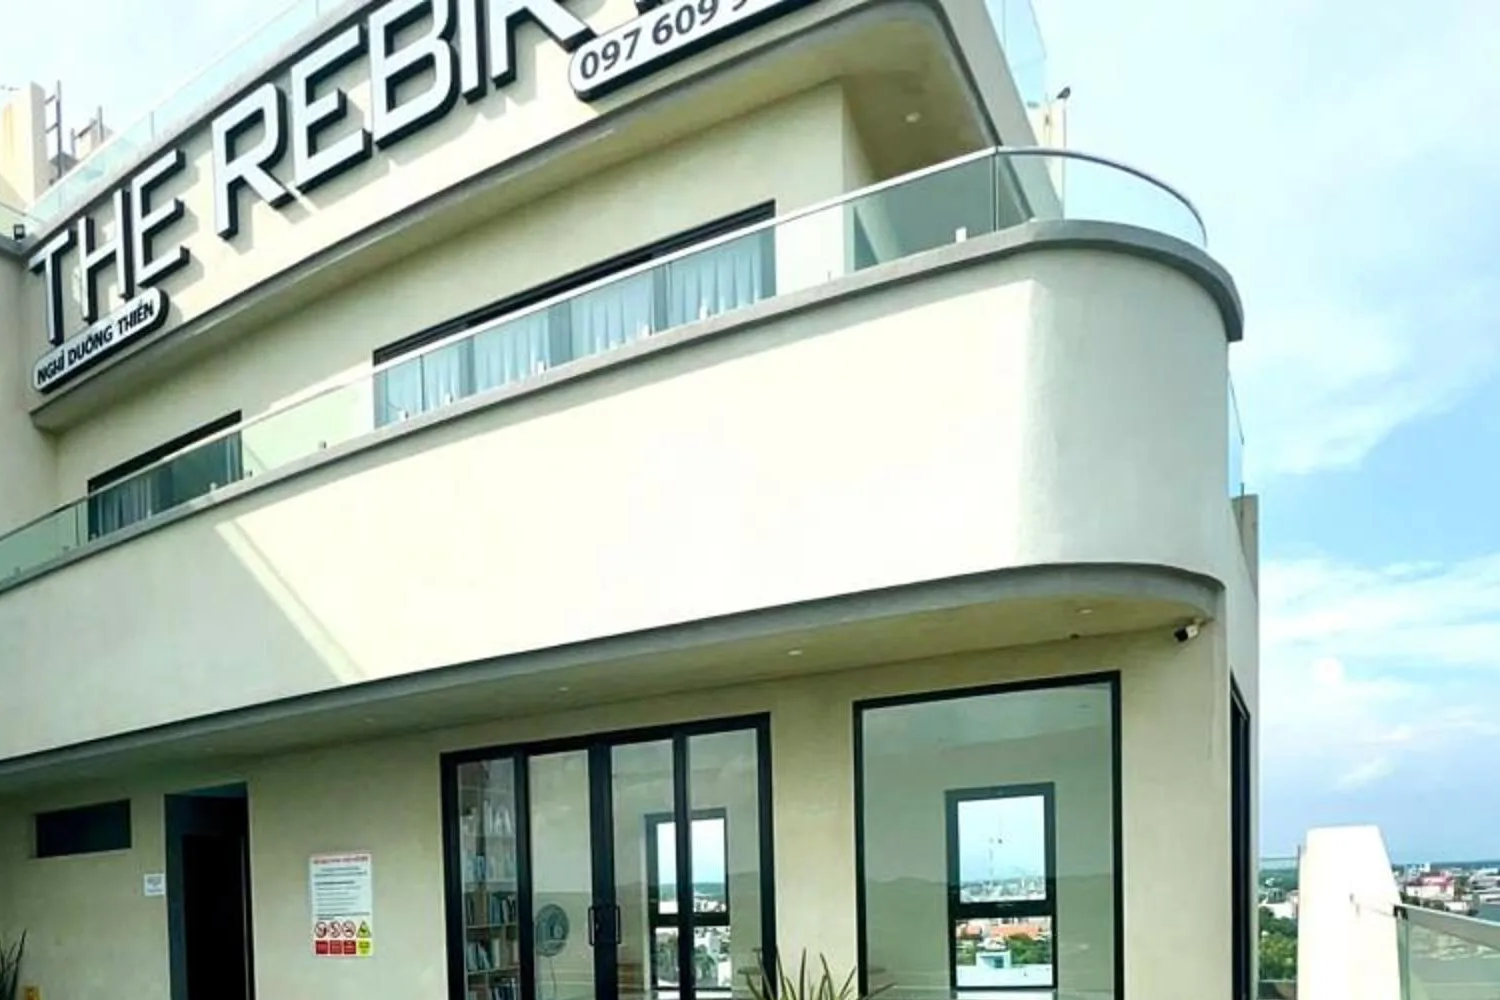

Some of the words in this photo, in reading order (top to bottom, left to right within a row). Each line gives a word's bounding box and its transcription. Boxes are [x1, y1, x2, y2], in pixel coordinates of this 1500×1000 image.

[579, 26, 642, 80] 097
[651, 0, 719, 46] 609
[28, 148, 190, 346] THE
